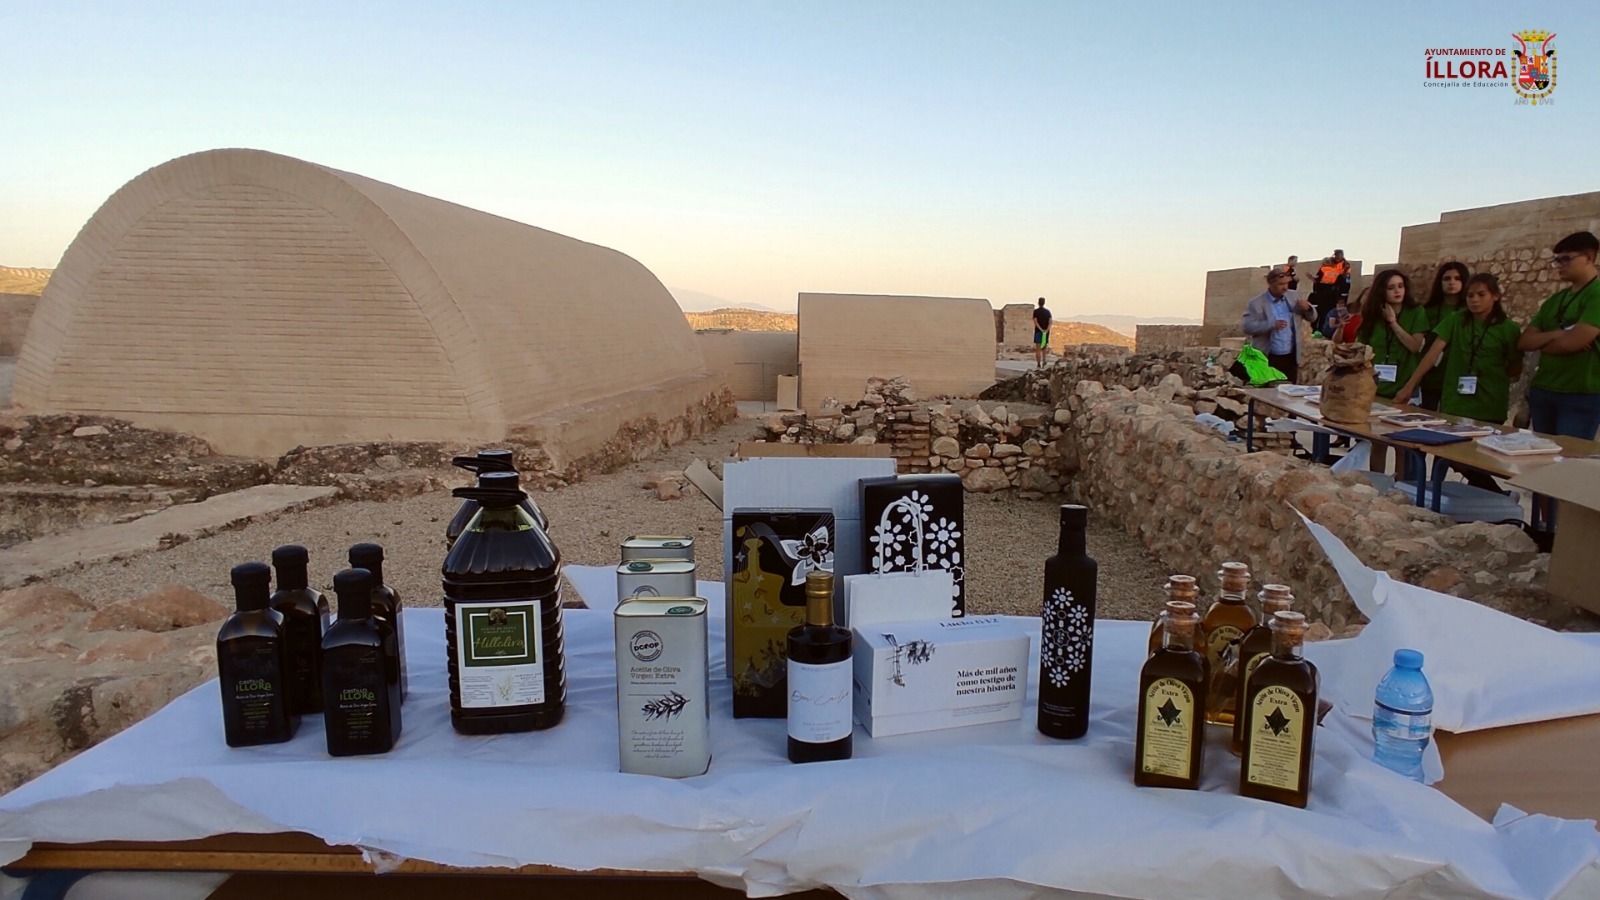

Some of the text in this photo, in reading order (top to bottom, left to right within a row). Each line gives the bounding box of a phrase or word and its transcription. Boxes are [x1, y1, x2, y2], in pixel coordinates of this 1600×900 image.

[957, 666, 1017, 678] Más de mil años
[956, 674, 1016, 687] como testigo de
[1166, 679, 1181, 689] Oliva
[956, 683, 1016, 696] nuestra historia
[1162, 689, 1179, 697] Extra
[1274, 687, 1290, 697] Oliva
[1269, 698, 1288, 706] Extra
